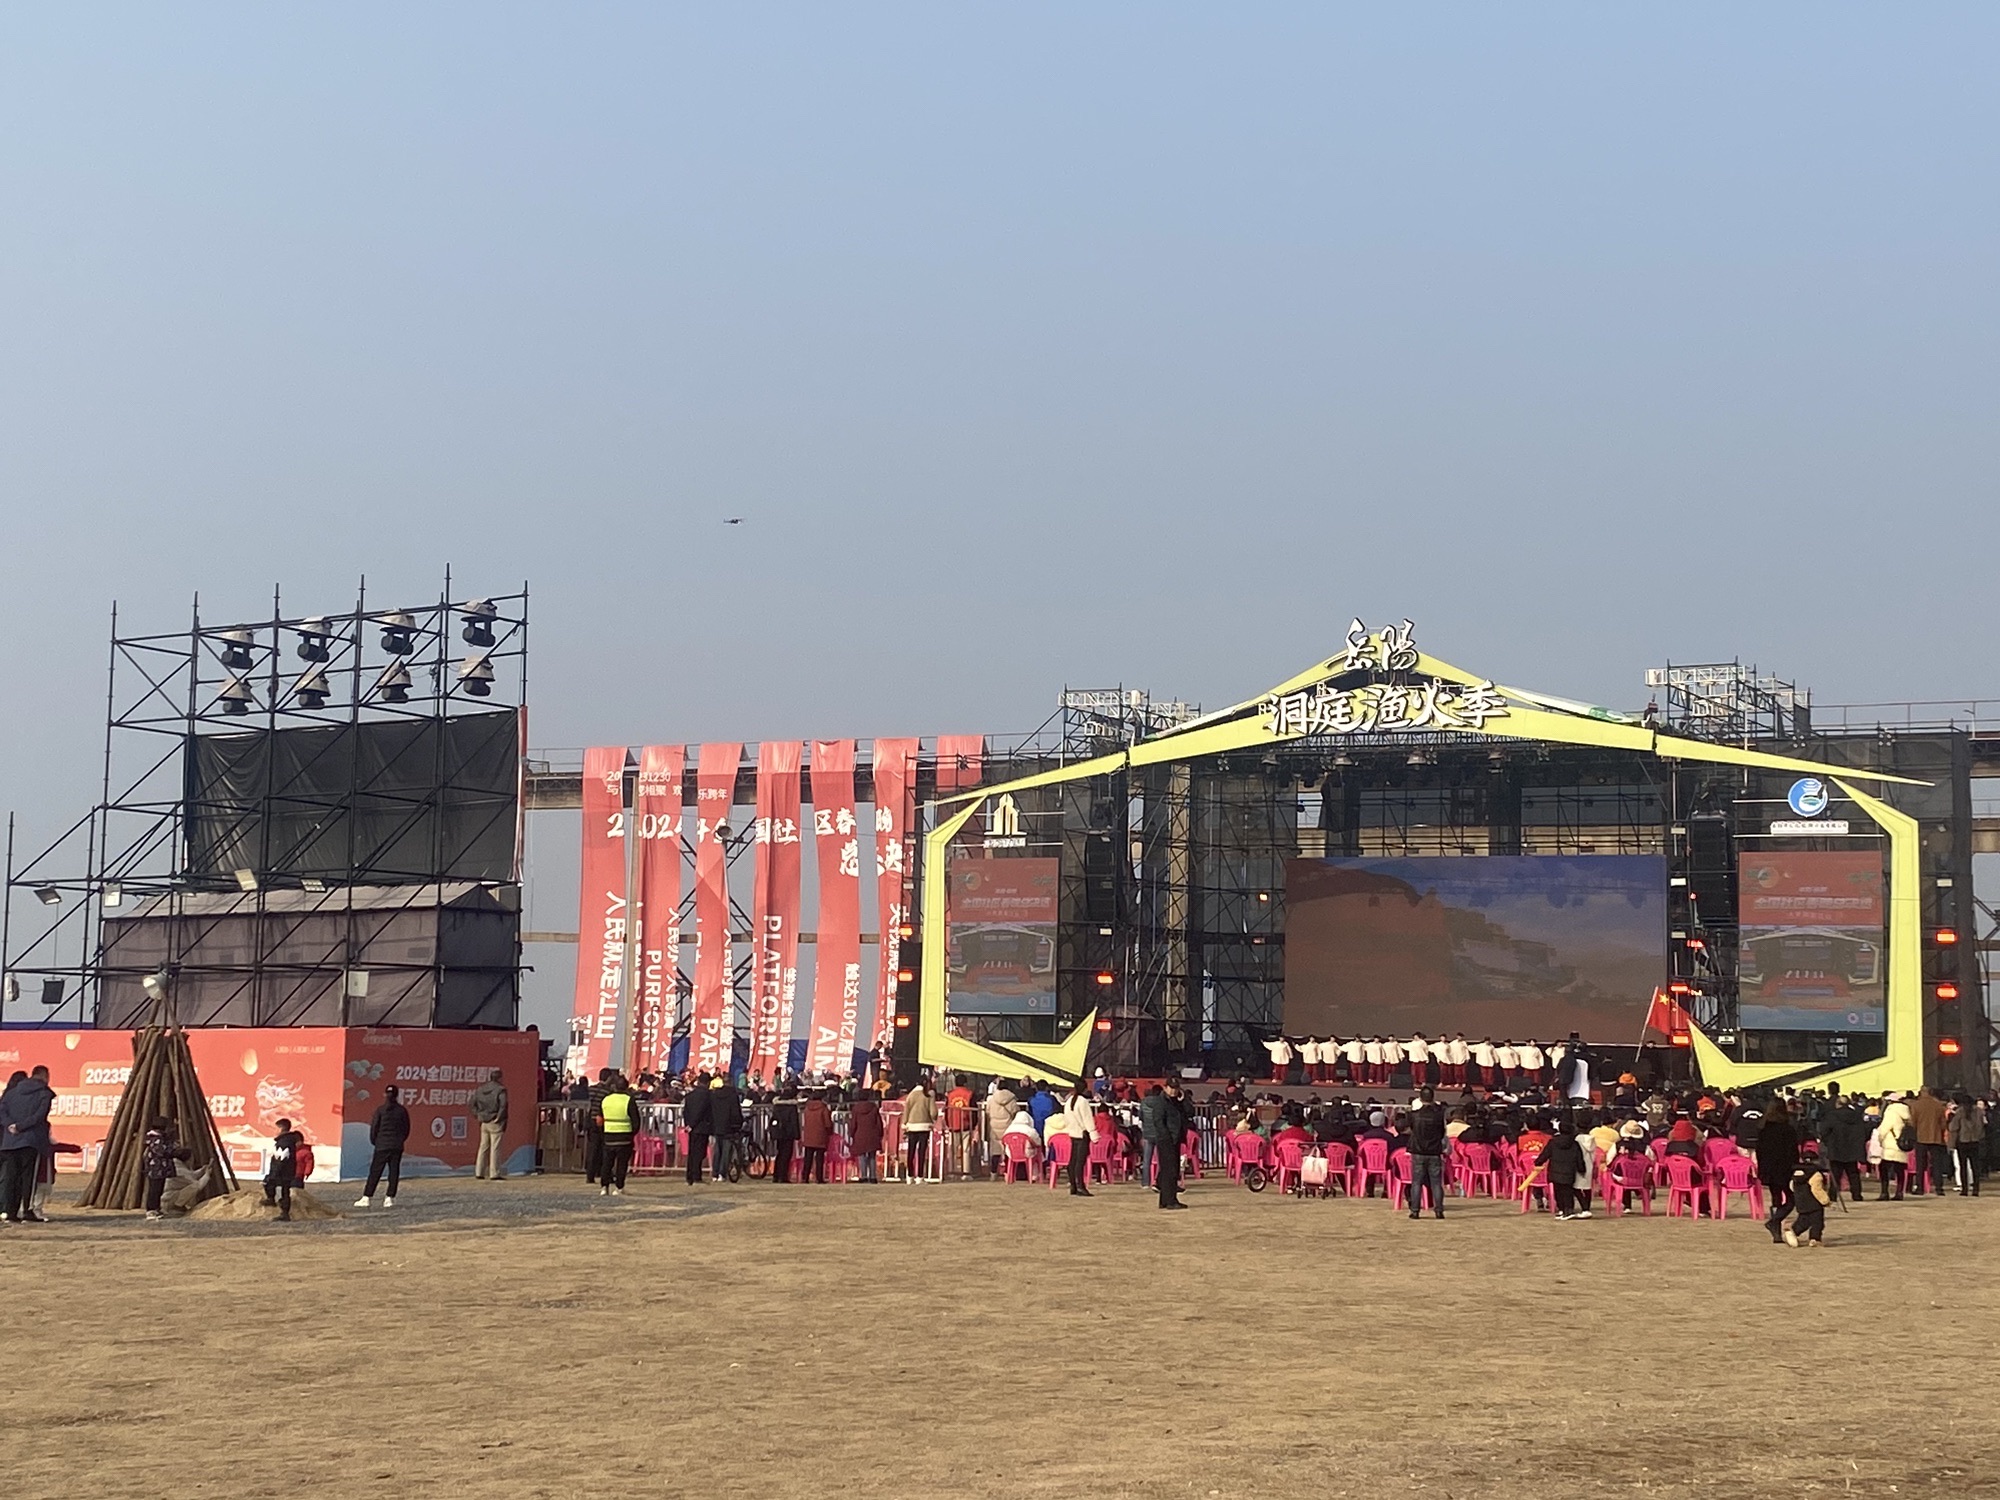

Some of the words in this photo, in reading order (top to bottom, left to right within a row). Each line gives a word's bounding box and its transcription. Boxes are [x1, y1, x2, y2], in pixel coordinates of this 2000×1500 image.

[1263, 680, 1511, 736] 洞庭渔火季
[757, 915, 783, 1057] PLATFORM
[206, 1095, 246, 1117] 狂欢
